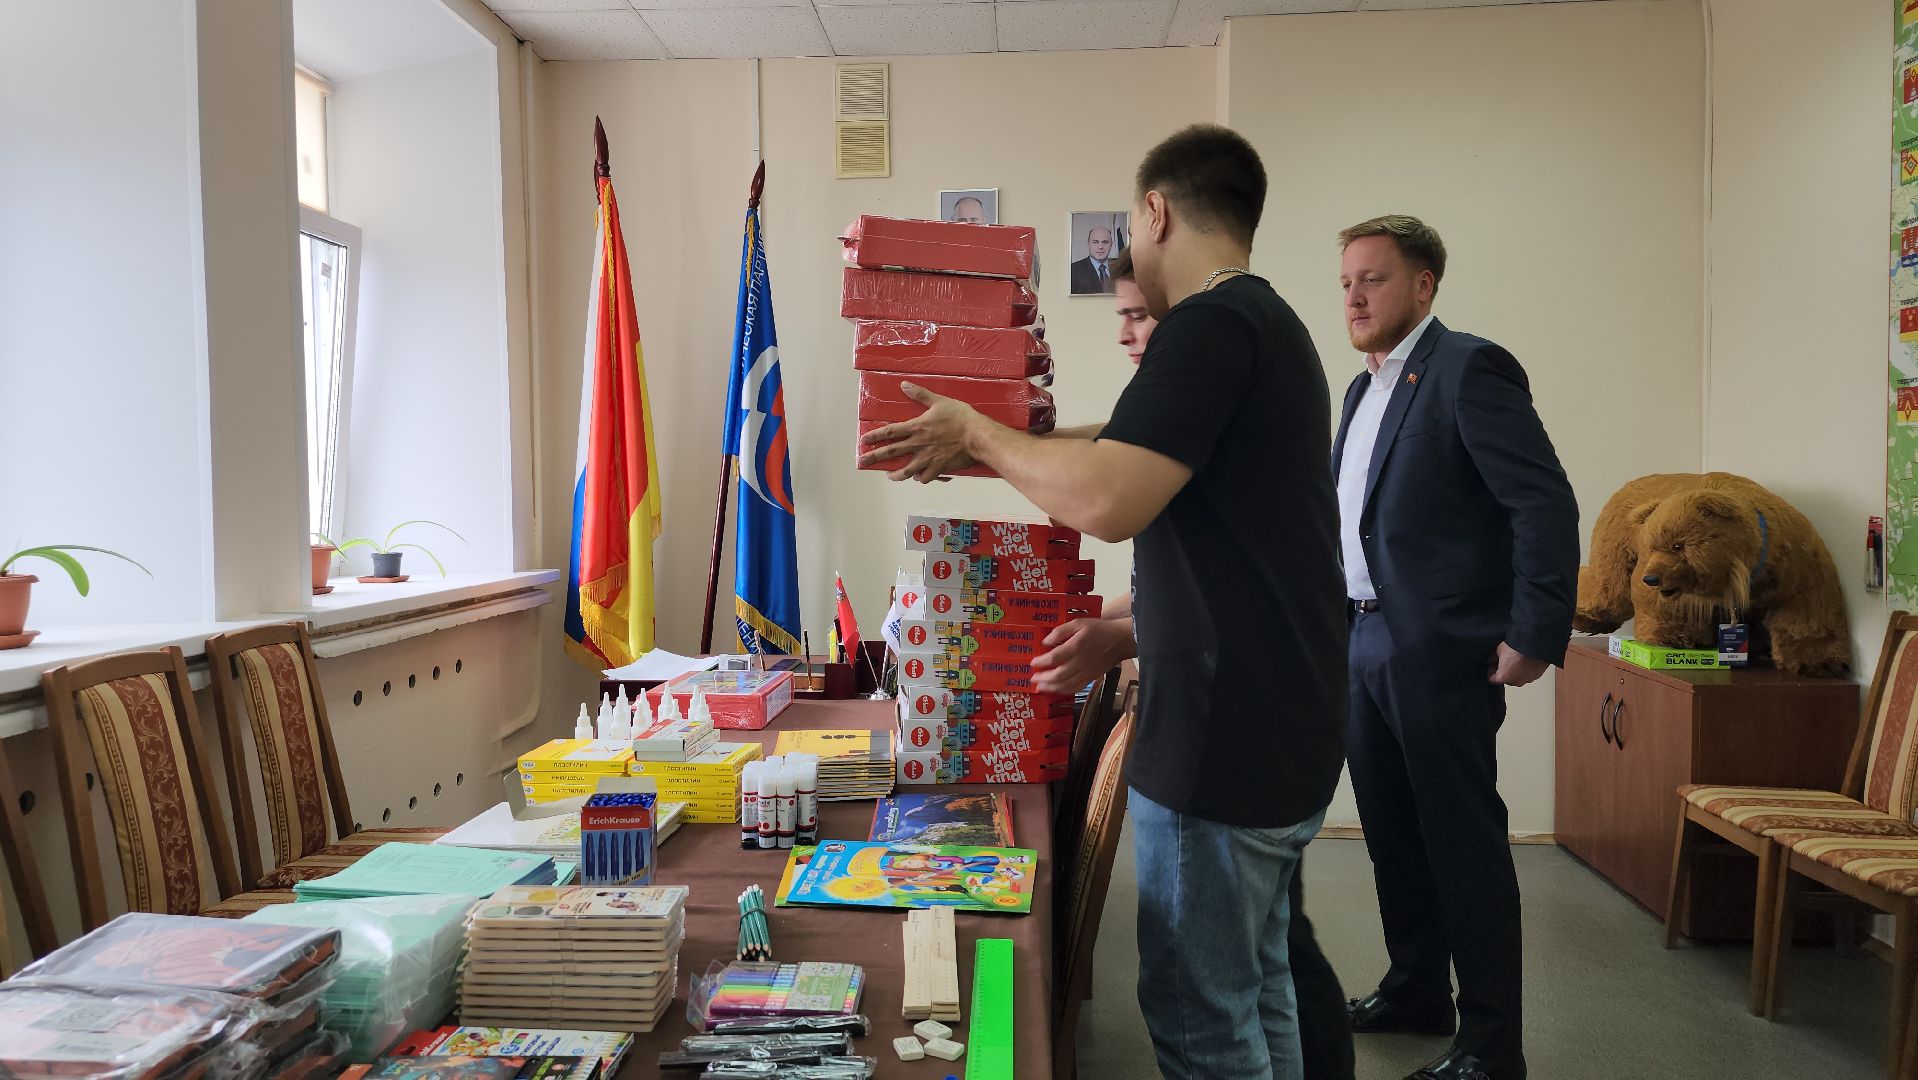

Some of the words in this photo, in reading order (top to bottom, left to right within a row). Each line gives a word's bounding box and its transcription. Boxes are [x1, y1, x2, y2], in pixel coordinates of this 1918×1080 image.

[1002, 531, 1030, 545] der
[992, 541, 1035, 558] kind!
[1021, 566, 1048, 580] der
[1012, 576, 1054, 592] kind!
[1004, 697, 1031, 711] der
[999, 727, 1026, 743] der
[990, 737, 1032, 752] kind!
[993, 759, 1020, 774] der
[984, 770, 1028, 783] kind!
[588, 816, 641, 825] ErichKrause
